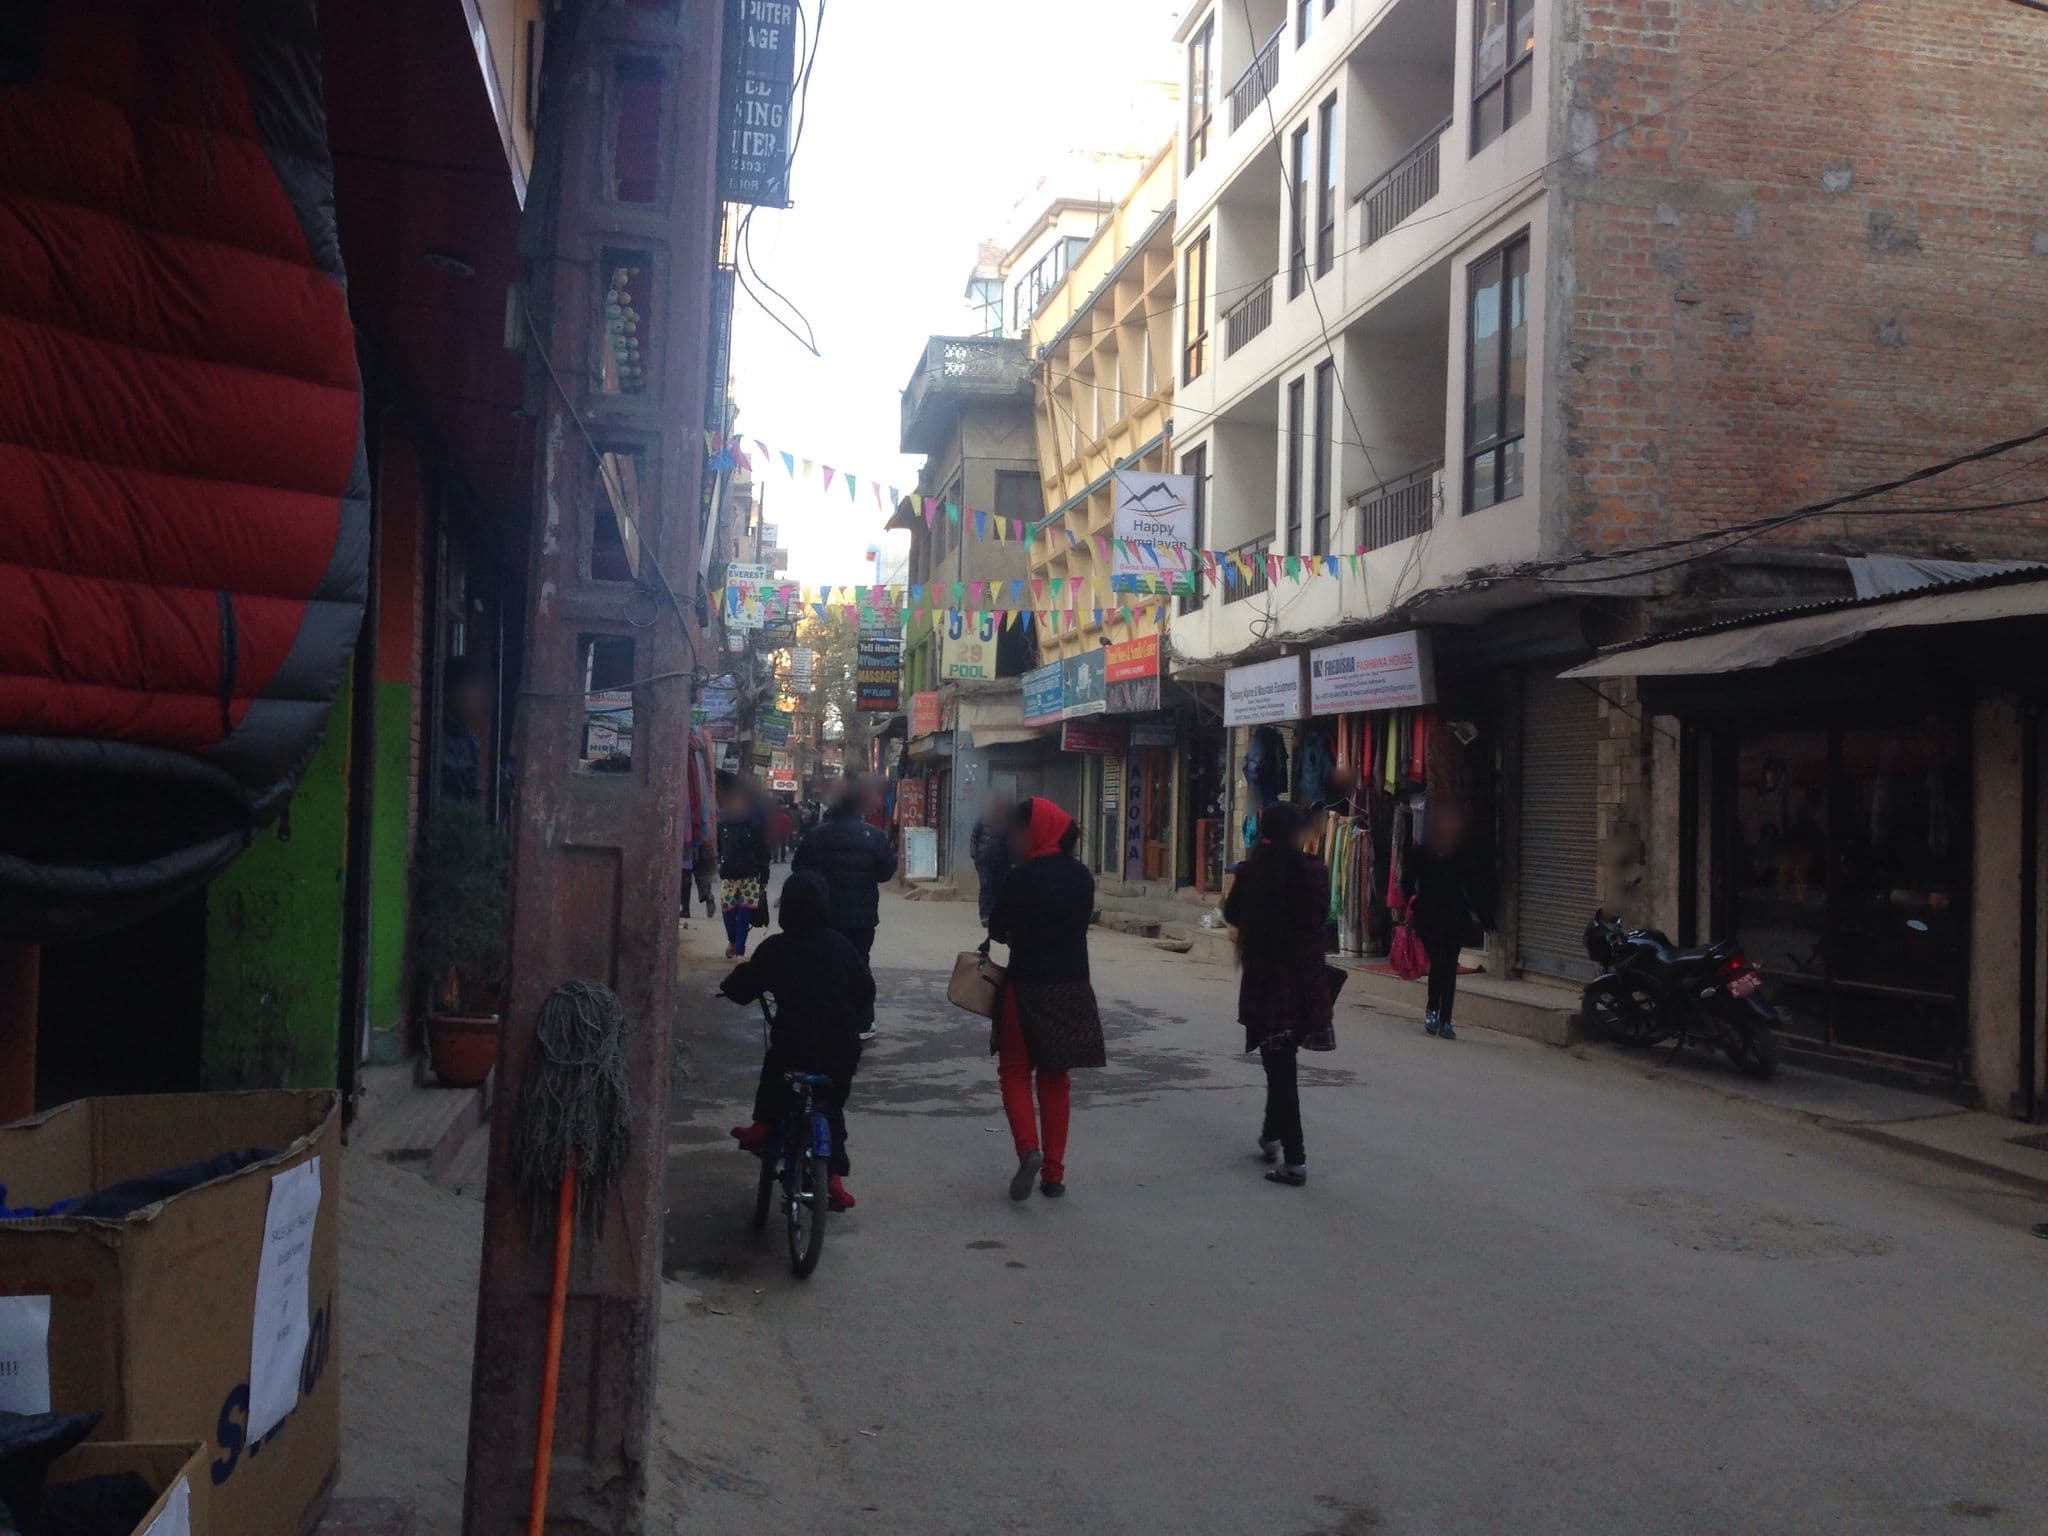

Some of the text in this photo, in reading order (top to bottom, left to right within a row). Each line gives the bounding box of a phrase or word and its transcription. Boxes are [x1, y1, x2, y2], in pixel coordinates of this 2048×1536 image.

[1133, 520, 1175, 537] Happy
[728, 570, 765, 580] EVEREST
[1388, 652, 1414, 668] HOUSE
[858, 670, 898, 684] MASSAGE
[949, 664, 988, 679] POOL
[1129, 765, 1142, 862] AROMA
